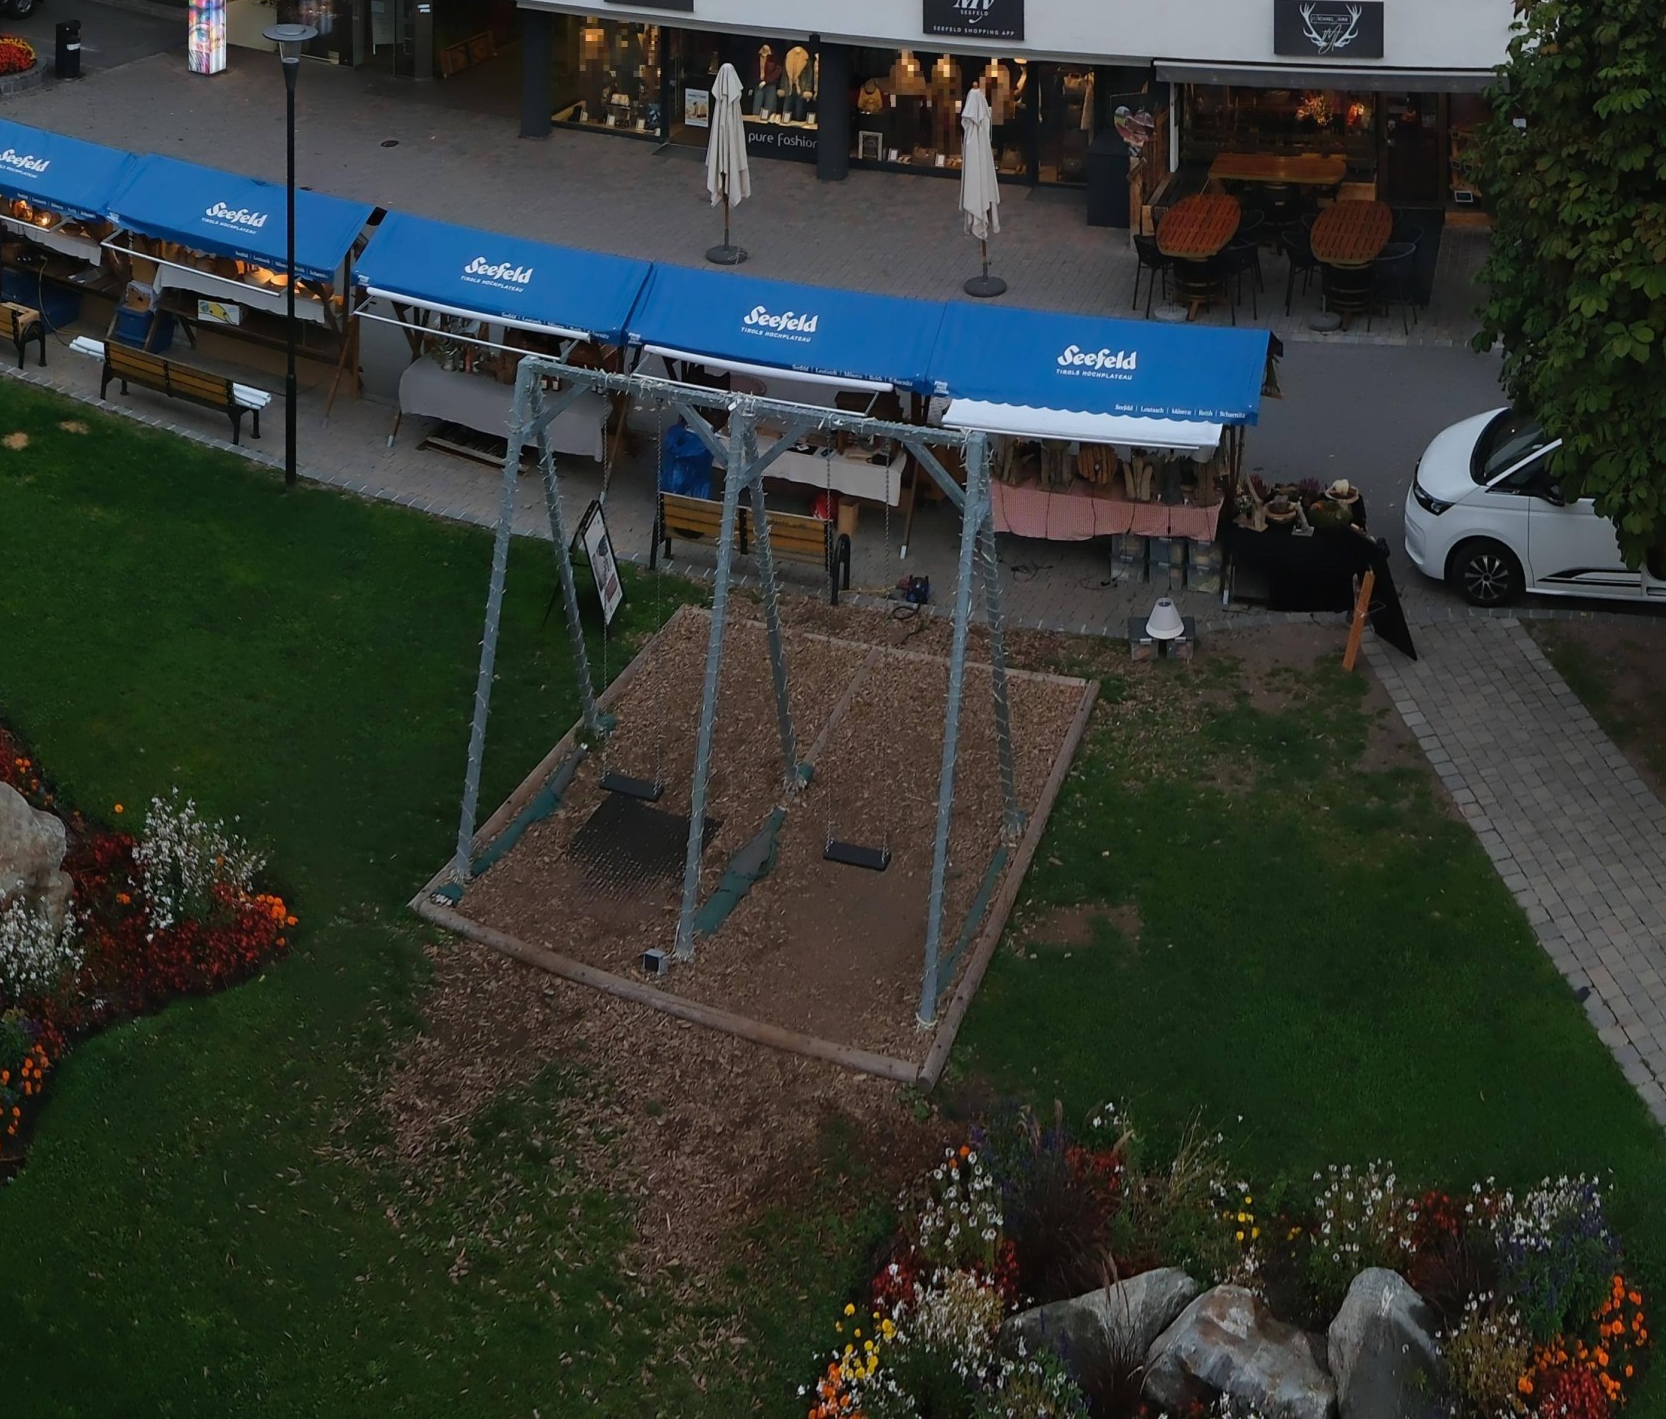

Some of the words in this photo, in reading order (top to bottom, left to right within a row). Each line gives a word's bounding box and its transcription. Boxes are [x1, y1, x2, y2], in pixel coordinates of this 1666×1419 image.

[933, 25, 962, 33] SEEFELD
[964, 27, 999, 36] SHOPPING
[748, 132, 774, 143] pure
[205, 201, 269, 229] Seefeld
[464, 256, 533, 285] Seefeld
[743, 304, 820, 334] Seefeld
[1056, 344, 1137, 372] Seefeld
[1056, 368, 1080, 376] TIROLS
